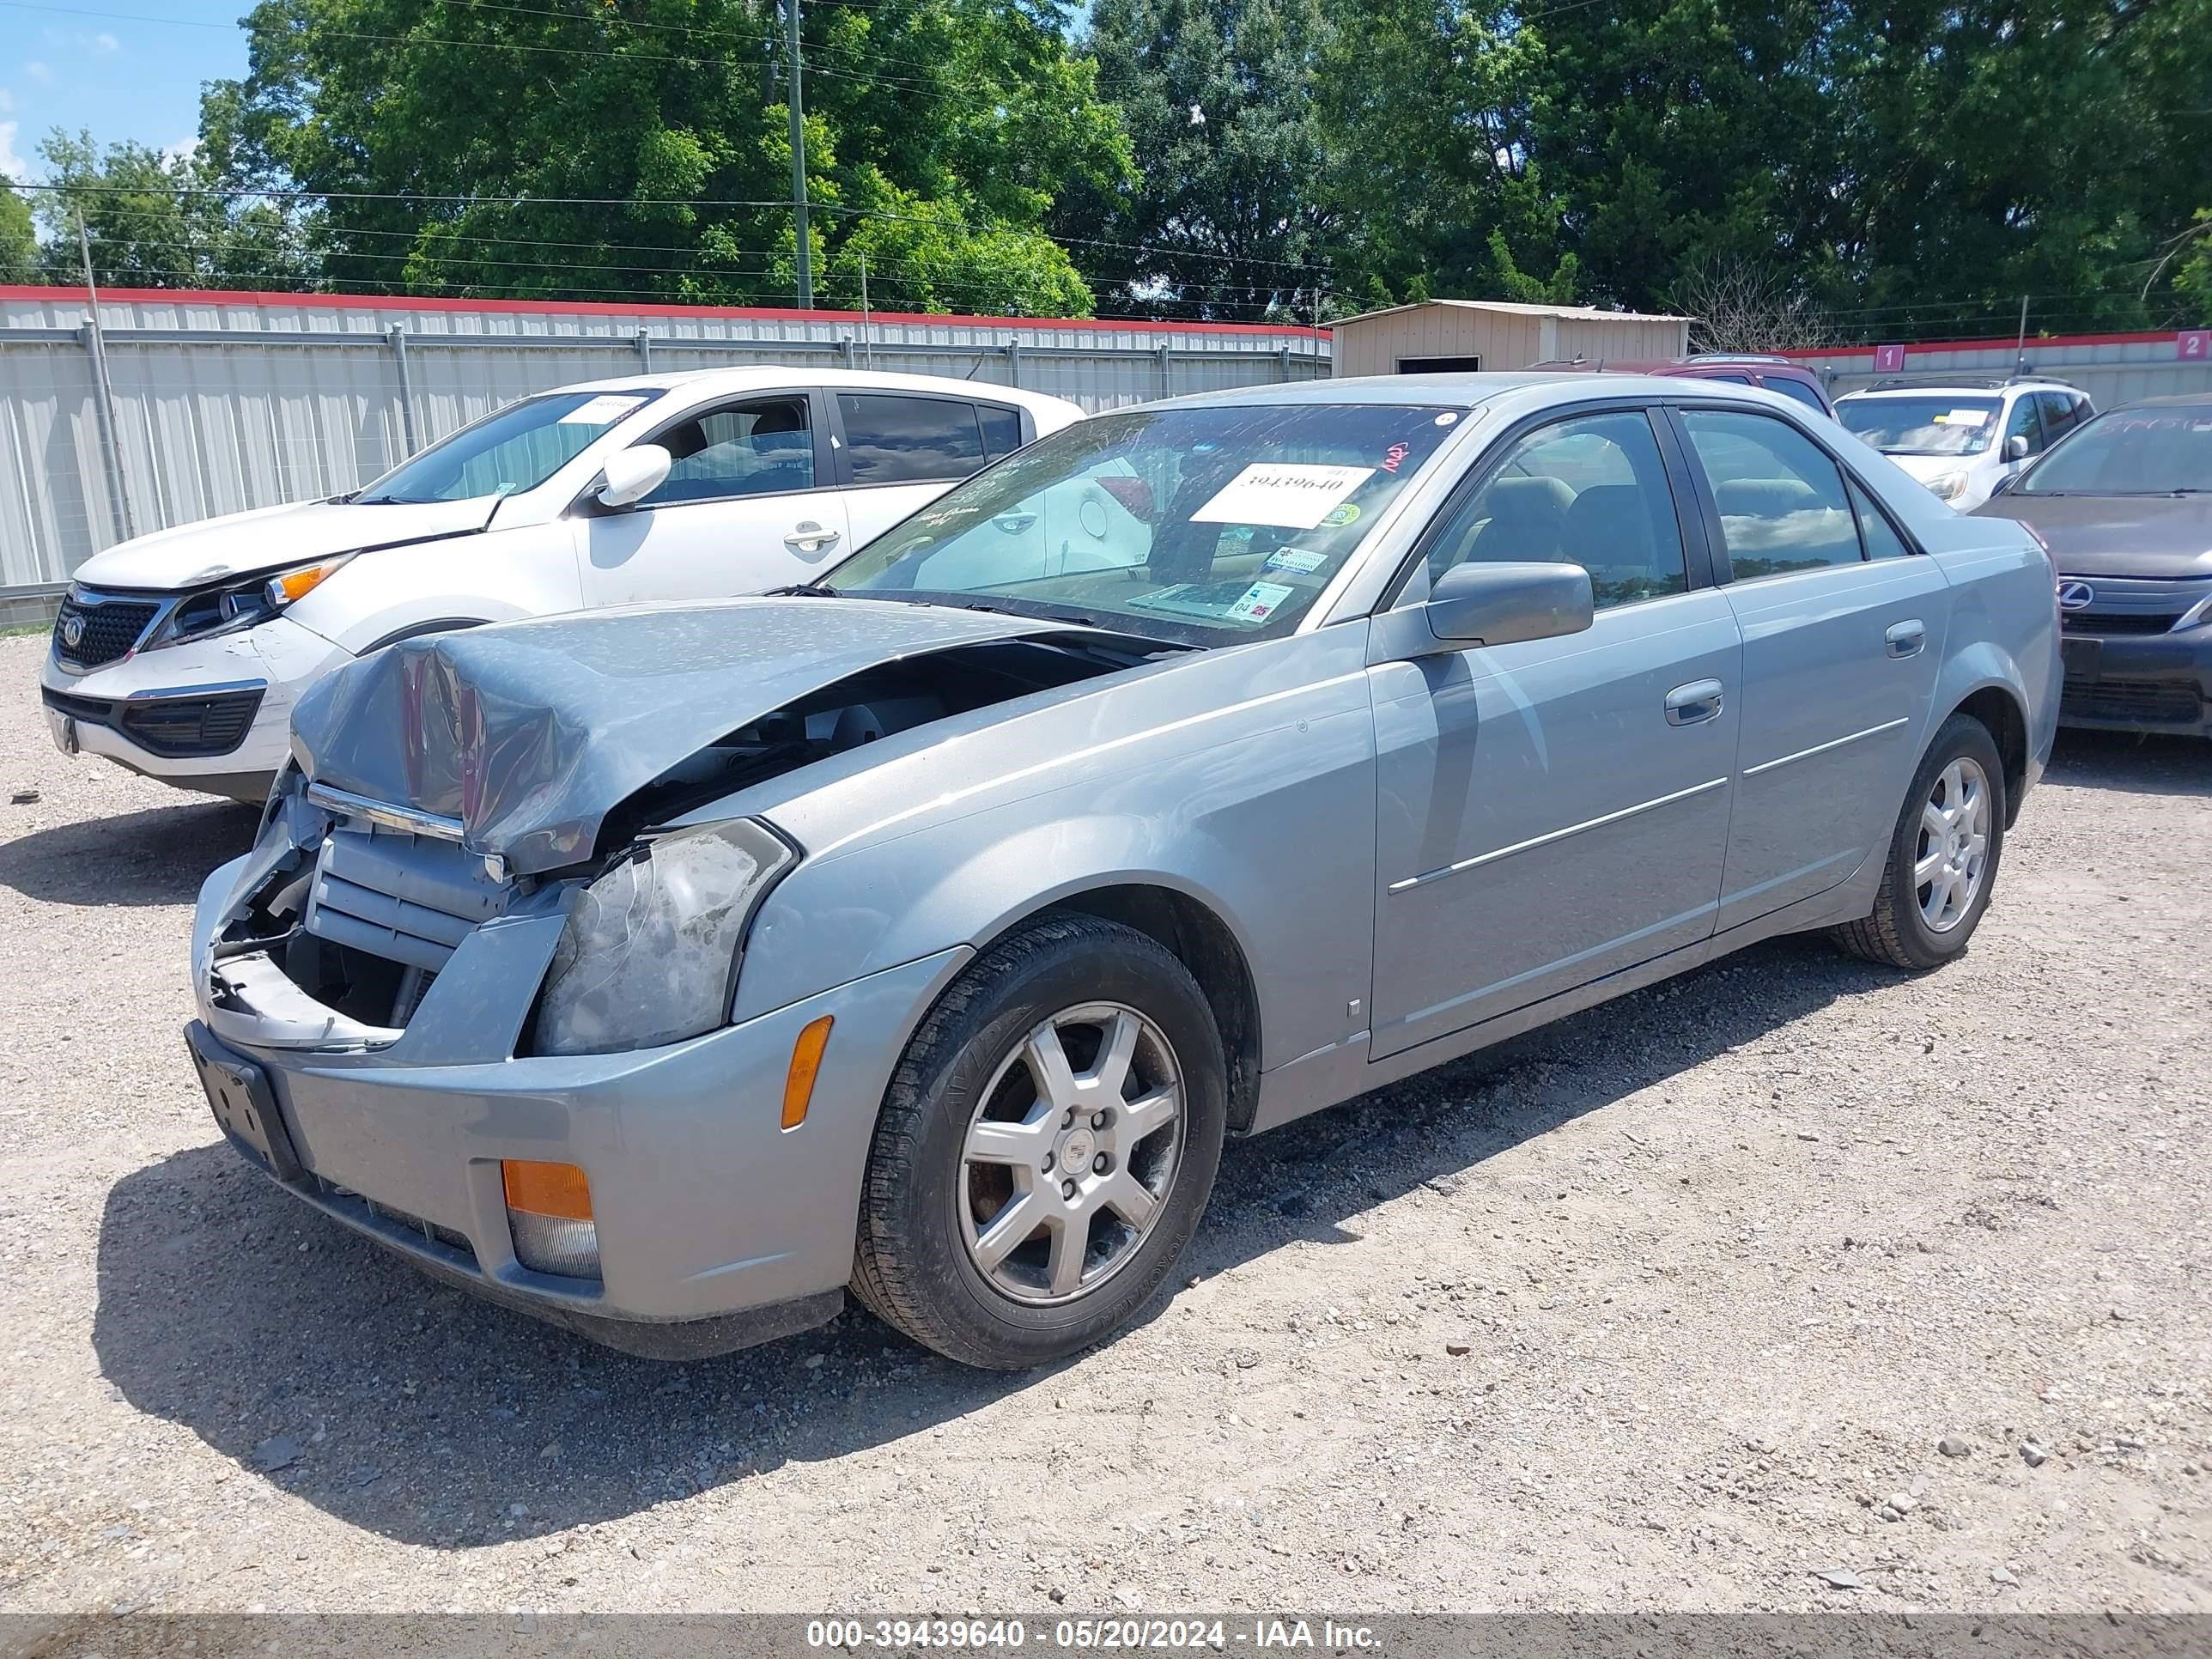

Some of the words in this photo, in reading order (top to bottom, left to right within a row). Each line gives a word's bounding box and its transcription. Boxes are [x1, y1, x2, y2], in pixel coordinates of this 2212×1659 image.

[2186, 337, 2199, 354] 2
[1885, 349, 1893, 366] 1
[1234, 603, 1251, 612] 04
[1252, 605, 1268, 616] 25
